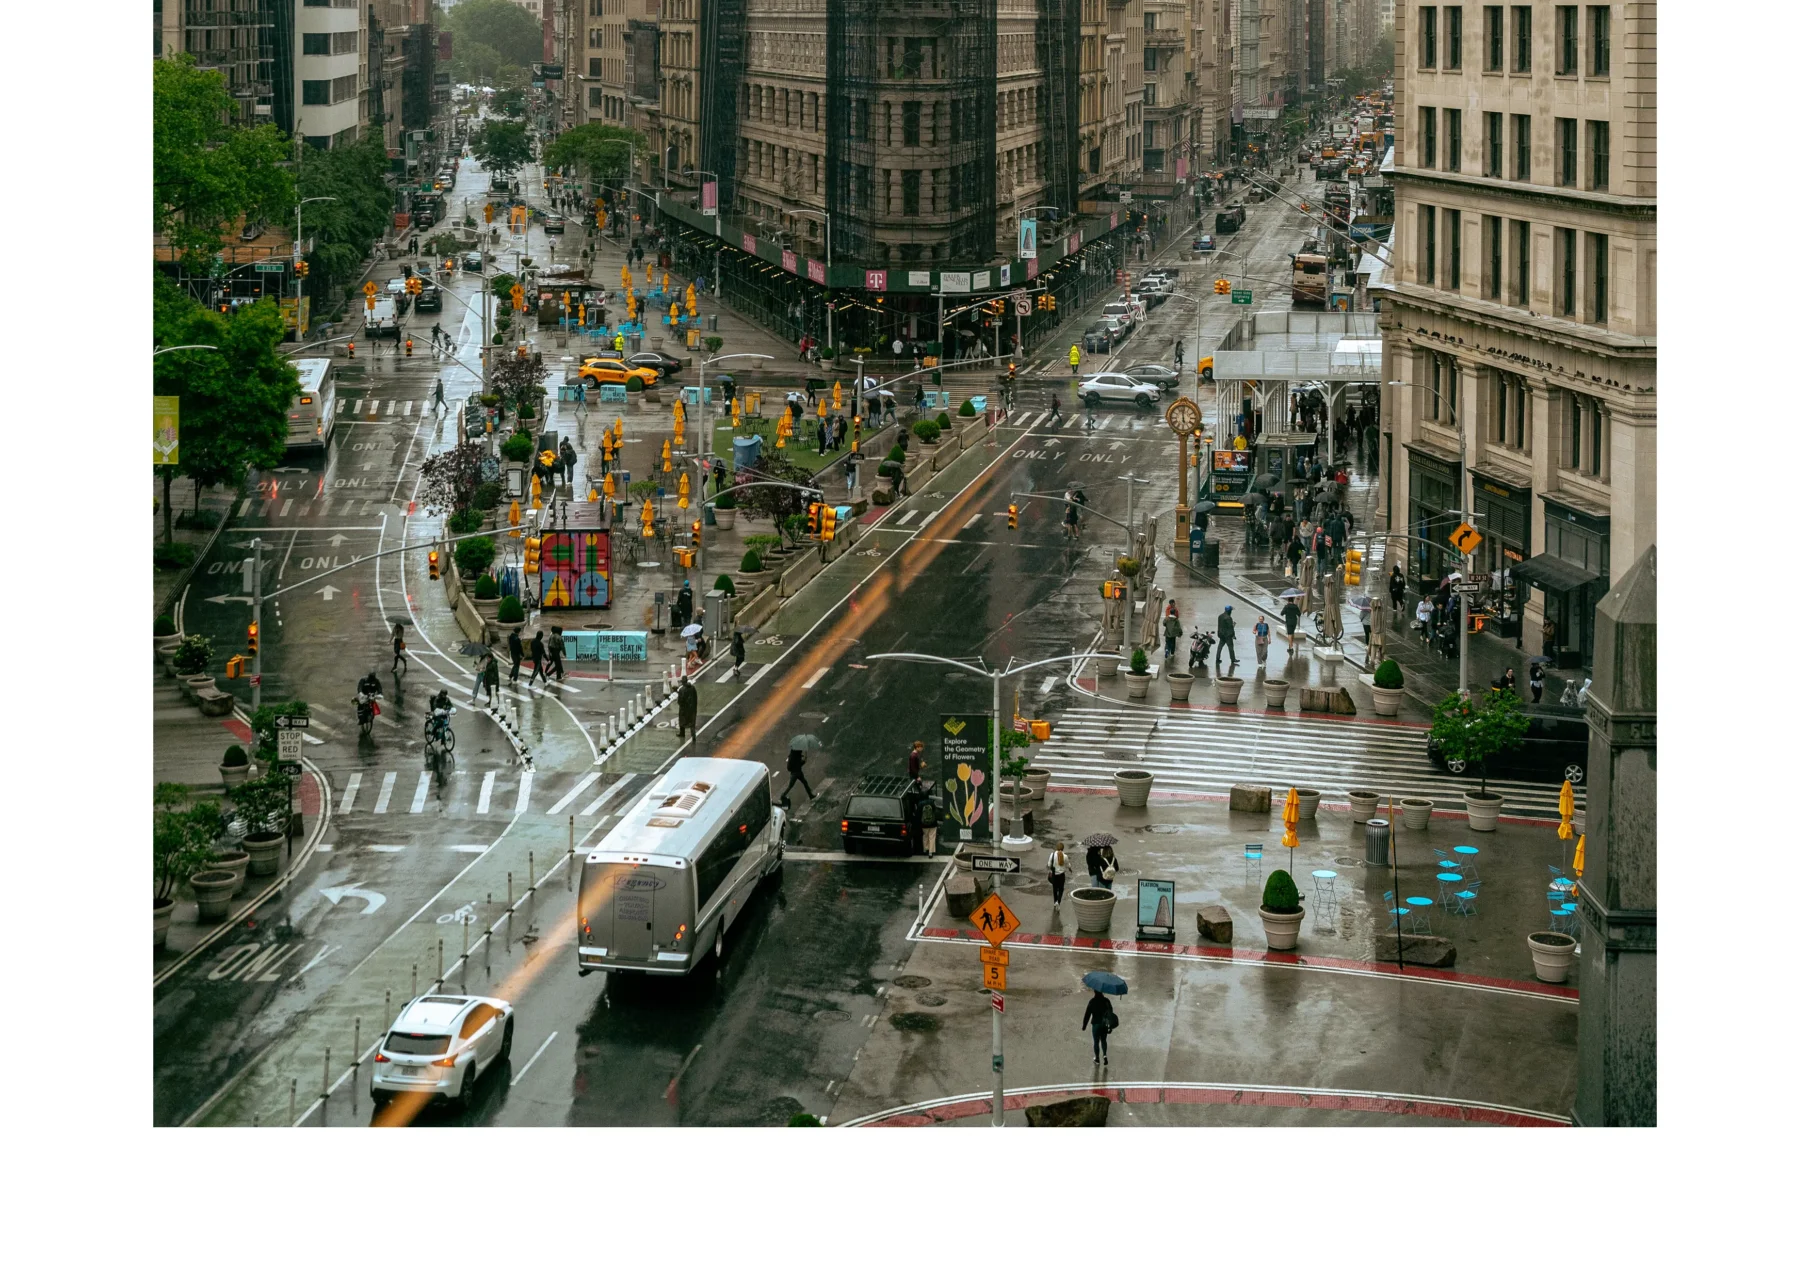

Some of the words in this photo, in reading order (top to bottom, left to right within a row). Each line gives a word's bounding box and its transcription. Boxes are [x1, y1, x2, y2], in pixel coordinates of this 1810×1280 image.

[352, 441, 401, 452] ONLY
[1012, 449, 1066, 460] ONLY
[1079, 453, 1132, 464] ONLY
[256, 479, 308, 492] ONLY
[300, 554, 362, 570] ONLY
[599, 635, 611, 643] THE
[611, 635, 627, 643] BEST
[620, 644, 634, 652] SEAT
[636, 644, 643, 652] IN
[621, 653, 641, 661] HOUSE
[280, 732, 300, 740] STOP
[944, 738, 967, 746] Explore
[282, 745, 298, 753] RED
[944, 745, 954, 753] the
[955, 746, 986, 754] Geometry
[998, 861, 1013, 869] WAY
[207, 942, 342, 982] ONLY
[991, 967, 999, 980] 5
